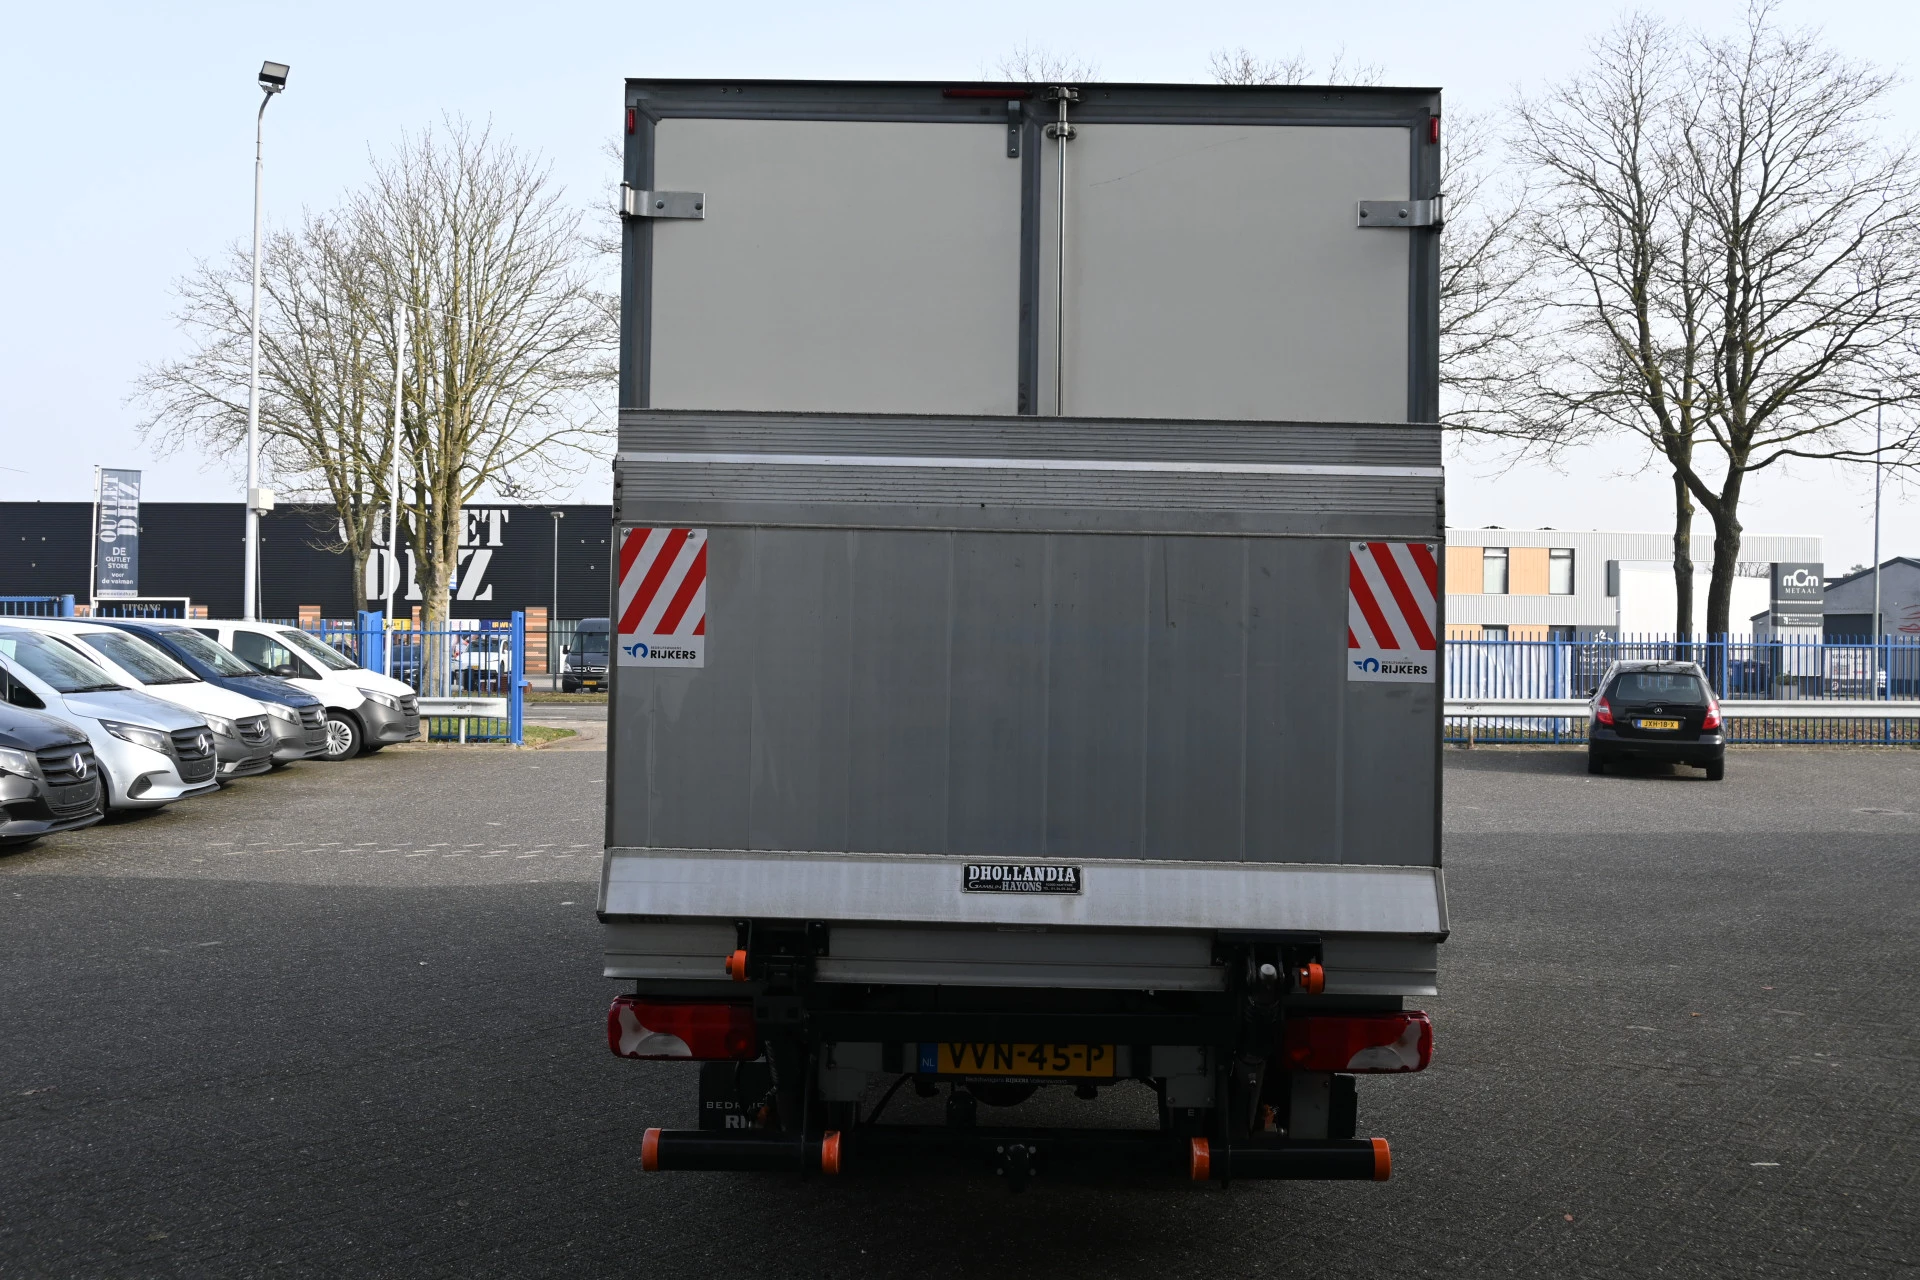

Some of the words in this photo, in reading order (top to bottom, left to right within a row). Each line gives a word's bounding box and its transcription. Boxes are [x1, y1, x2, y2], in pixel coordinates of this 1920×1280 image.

[100, 474, 119, 543] OUTLET
[117, 481, 140, 537] DHZ
[112, 547, 127, 556] DE
[122, 603, 161, 612] UITGANG
[650, 650, 696, 659] RIJKERS
[1381, 665, 1428, 674] RIJKERS
[1644, 720, 1675, 728] JXH-18-X
[968, 866, 1076, 881] DHOLLANDIA
[1001, 881, 1042, 891] HAYONS
[922, 1057, 935, 1067] NL
[949, 1043, 1104, 1072] VVN-45-P
